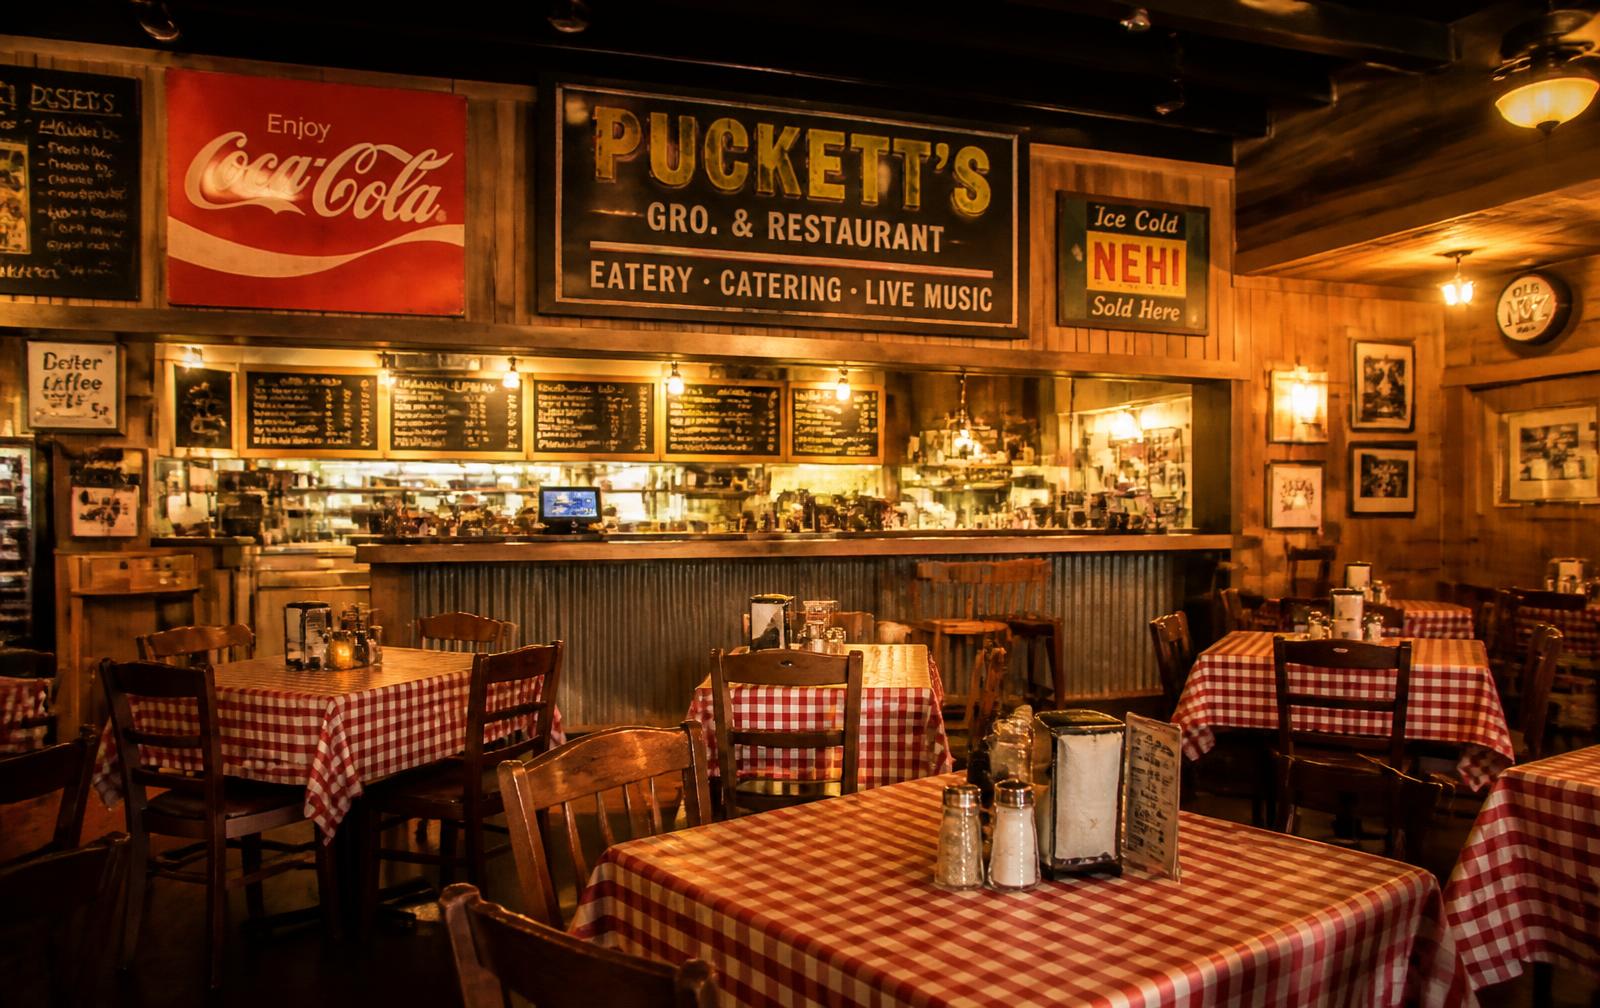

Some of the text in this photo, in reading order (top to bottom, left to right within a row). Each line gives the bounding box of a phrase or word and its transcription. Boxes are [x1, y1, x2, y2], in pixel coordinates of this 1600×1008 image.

[267, 113, 331, 143] Enjoy
[184, 131, 453, 224] Coca-Cola
[592, 105, 991, 217] PUCKETT'S
[647, 201, 944, 253] GRO. & RESTAURANT
[1094, 205, 1178, 233] Ice Cold
[590, 260, 993, 312] EATERY CATERING LIVE MUSIC
[1094, 241, 1179, 286] NEHI
[1092, 296, 1180, 321] Sold Here
